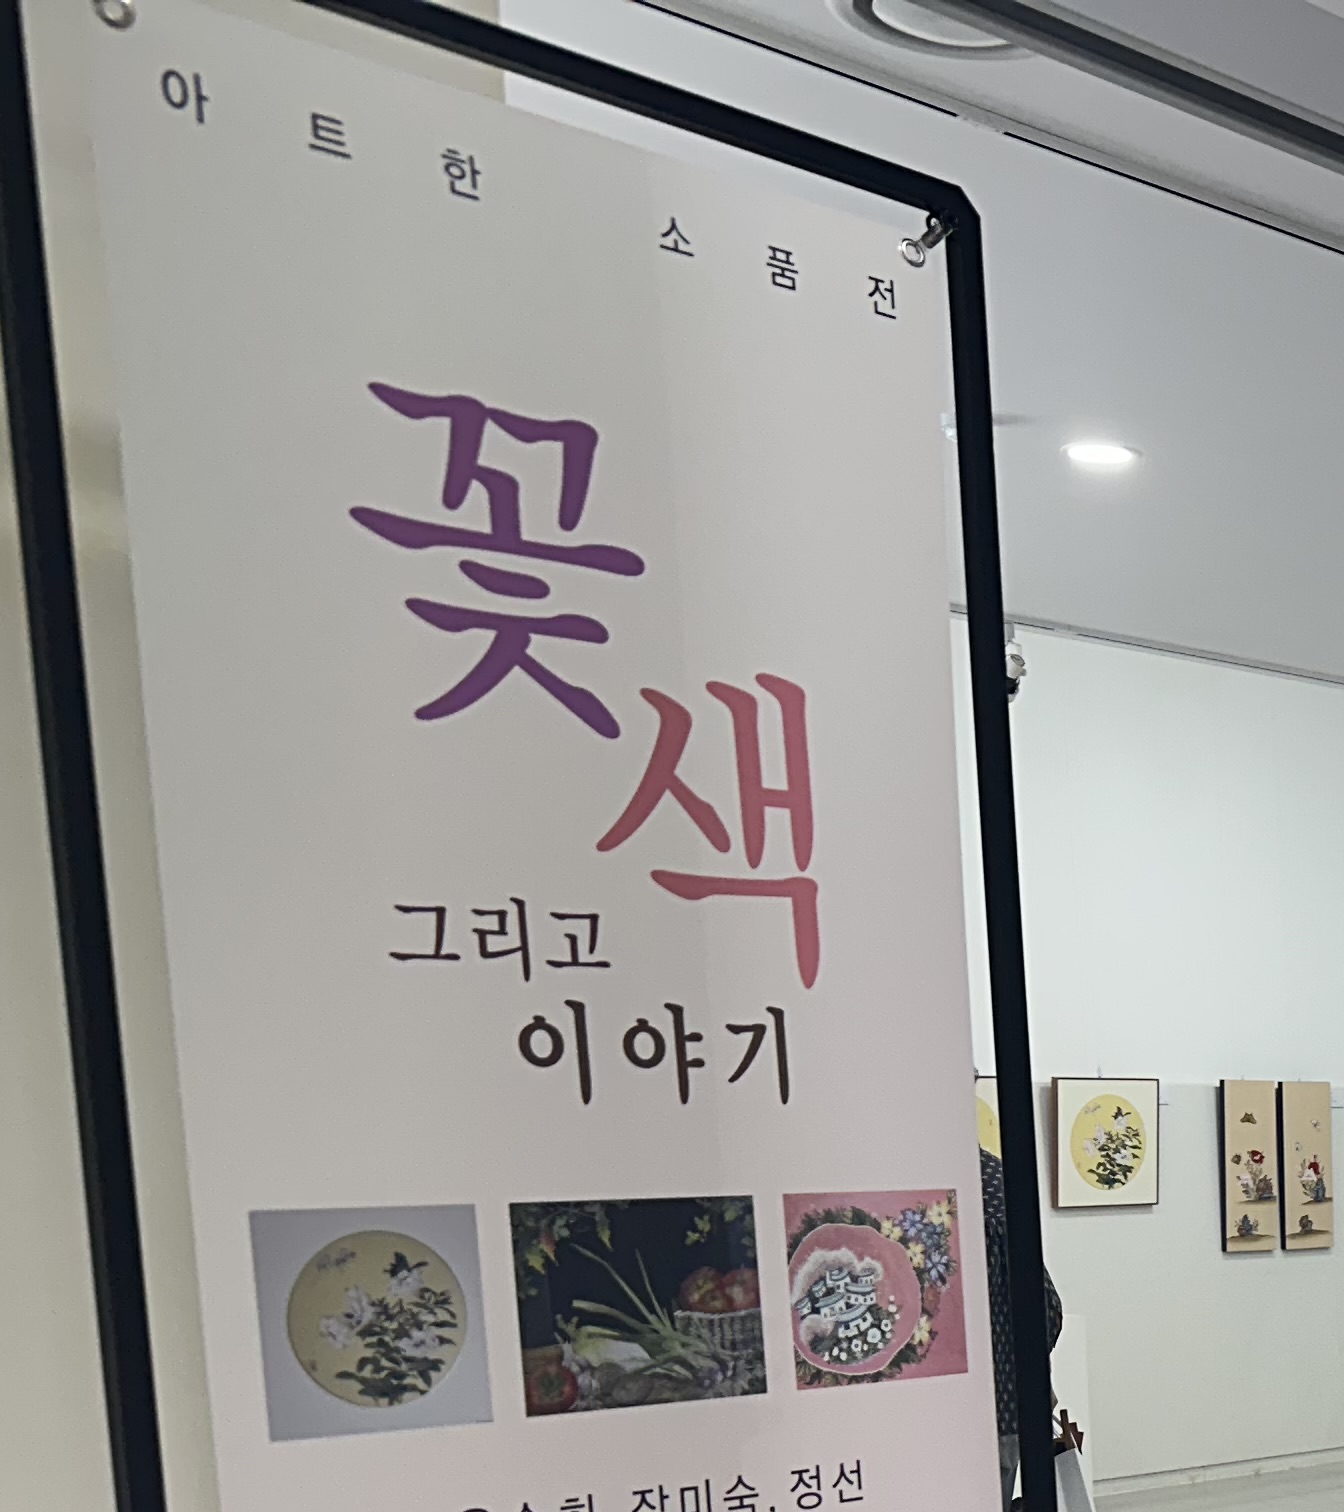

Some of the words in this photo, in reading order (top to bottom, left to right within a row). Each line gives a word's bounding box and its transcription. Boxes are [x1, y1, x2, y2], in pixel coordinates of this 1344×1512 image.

[350, 381, 646, 739] 꽃
[595, 672, 820, 989] 색
[388, 896, 613, 982] 그리고
[517, 998, 790, 1106] 이야기
[788, 1459, 864, 1510] 정선
